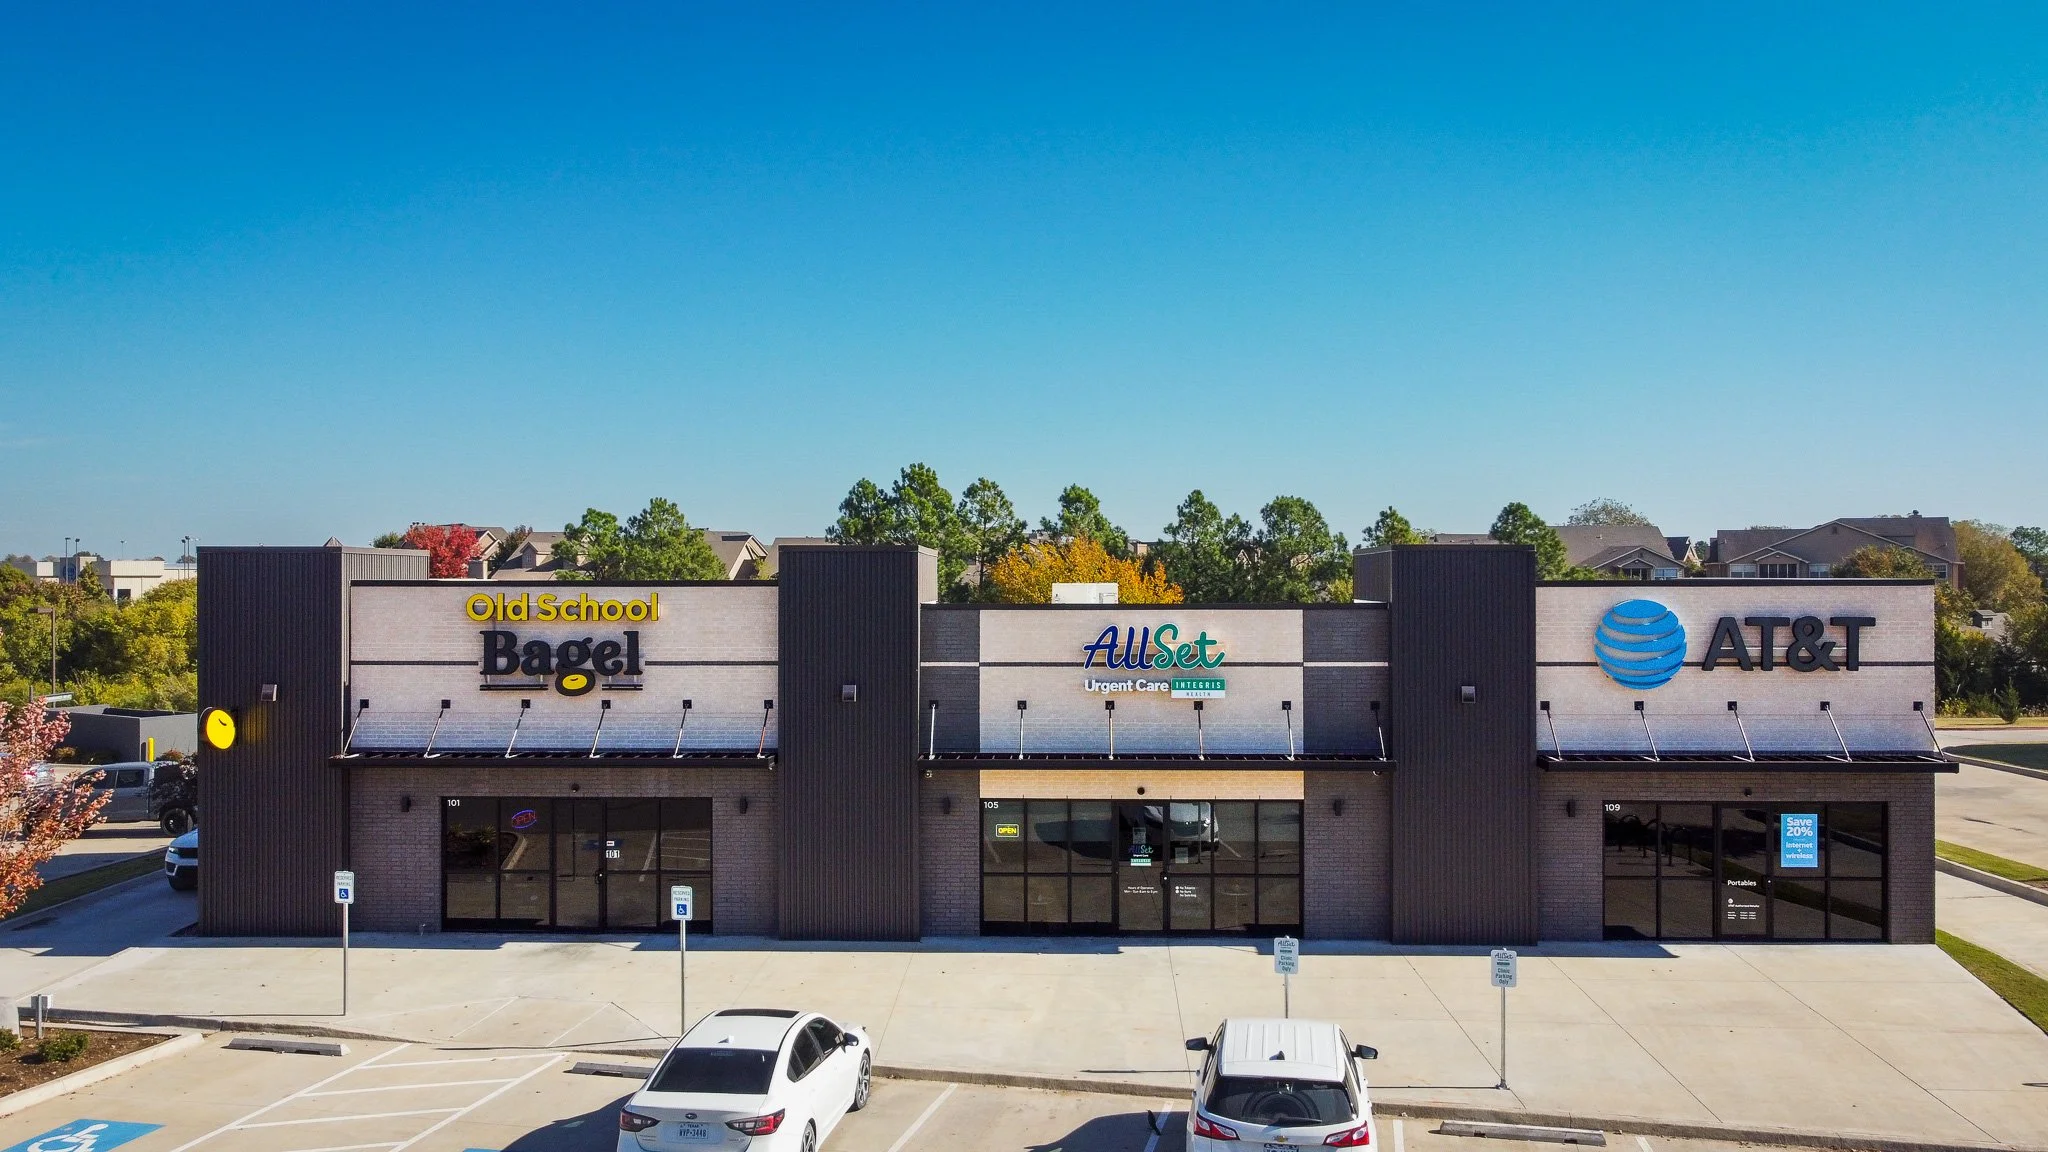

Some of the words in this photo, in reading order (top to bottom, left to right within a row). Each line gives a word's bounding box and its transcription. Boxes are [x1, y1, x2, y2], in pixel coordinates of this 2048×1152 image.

[466, 592, 530, 621] Old
[537, 592, 660, 621] School
[1083, 623, 1226, 670] AllSet
[1701, 615, 1877, 673] AT&T
[479, 630, 644, 697] Bagel
[1084, 679, 1132, 695] Urgent
[1135, 679, 1169, 692] Care
[1175, 681, 1221, 689] INTEGRIS
[983, 801, 999, 809] 105
[1604, 803, 1621, 812] 109
[1786, 816, 1813, 827] Save
[1786, 826, 1814, 837] 20%
[605, 849, 620, 858] 101
[1727, 879, 1757, 887] Portables
